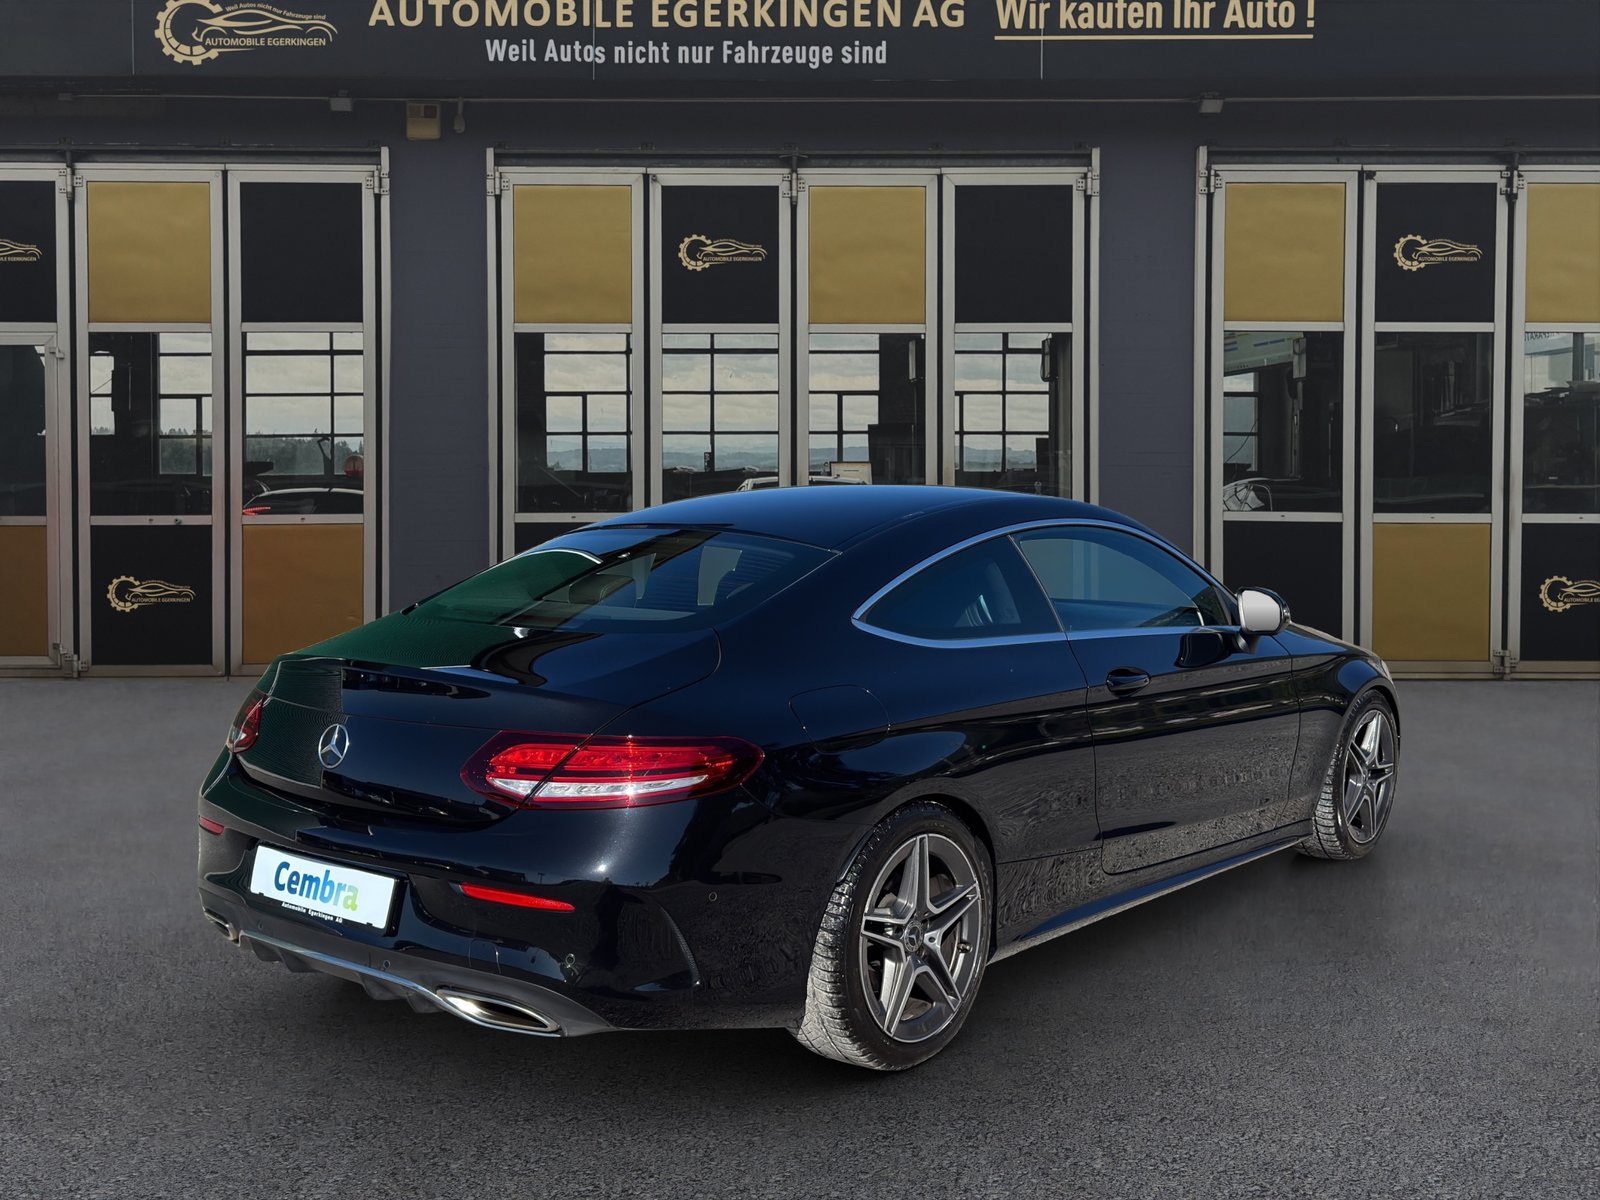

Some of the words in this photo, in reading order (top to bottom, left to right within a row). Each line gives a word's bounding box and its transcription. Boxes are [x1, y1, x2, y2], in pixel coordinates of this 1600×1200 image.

[225, 4, 239, 12] Weil
[257, 3, 273, 11] nicht
[283, 10, 313, 20] Fahrzeuge
[367, 0, 634, 27] AUTOMOBILE
[651, 0, 901, 27] EGERKINGEN
[911, 0, 966, 27] AG
[995, 0, 1050, 29] Wir
[1059, 0, 1163, 29] kaufen
[1173, 0, 1211, 29] Ihr
[1223, 0, 1296, 29] Auto
[1306, 0, 1316, 28] !
[205, 37, 266, 46] AUTOMOBILE
[267, 37, 326, 46] EGERKINGEN
[485, 39, 536, 62] Weil
[544, 39, 606, 63] Autos
[614, 41, 670, 64] nicht
[678, 45, 715, 64] nur
[722, 40, 833, 69] Fahrzeuge
[841, 40, 887, 64] sind
[274, 861, 359, 912] Cembra
[281, 901, 307, 913] Automobile
[308, 908, 334, 921] Egerkingen
[335, 915, 343, 924] AG
